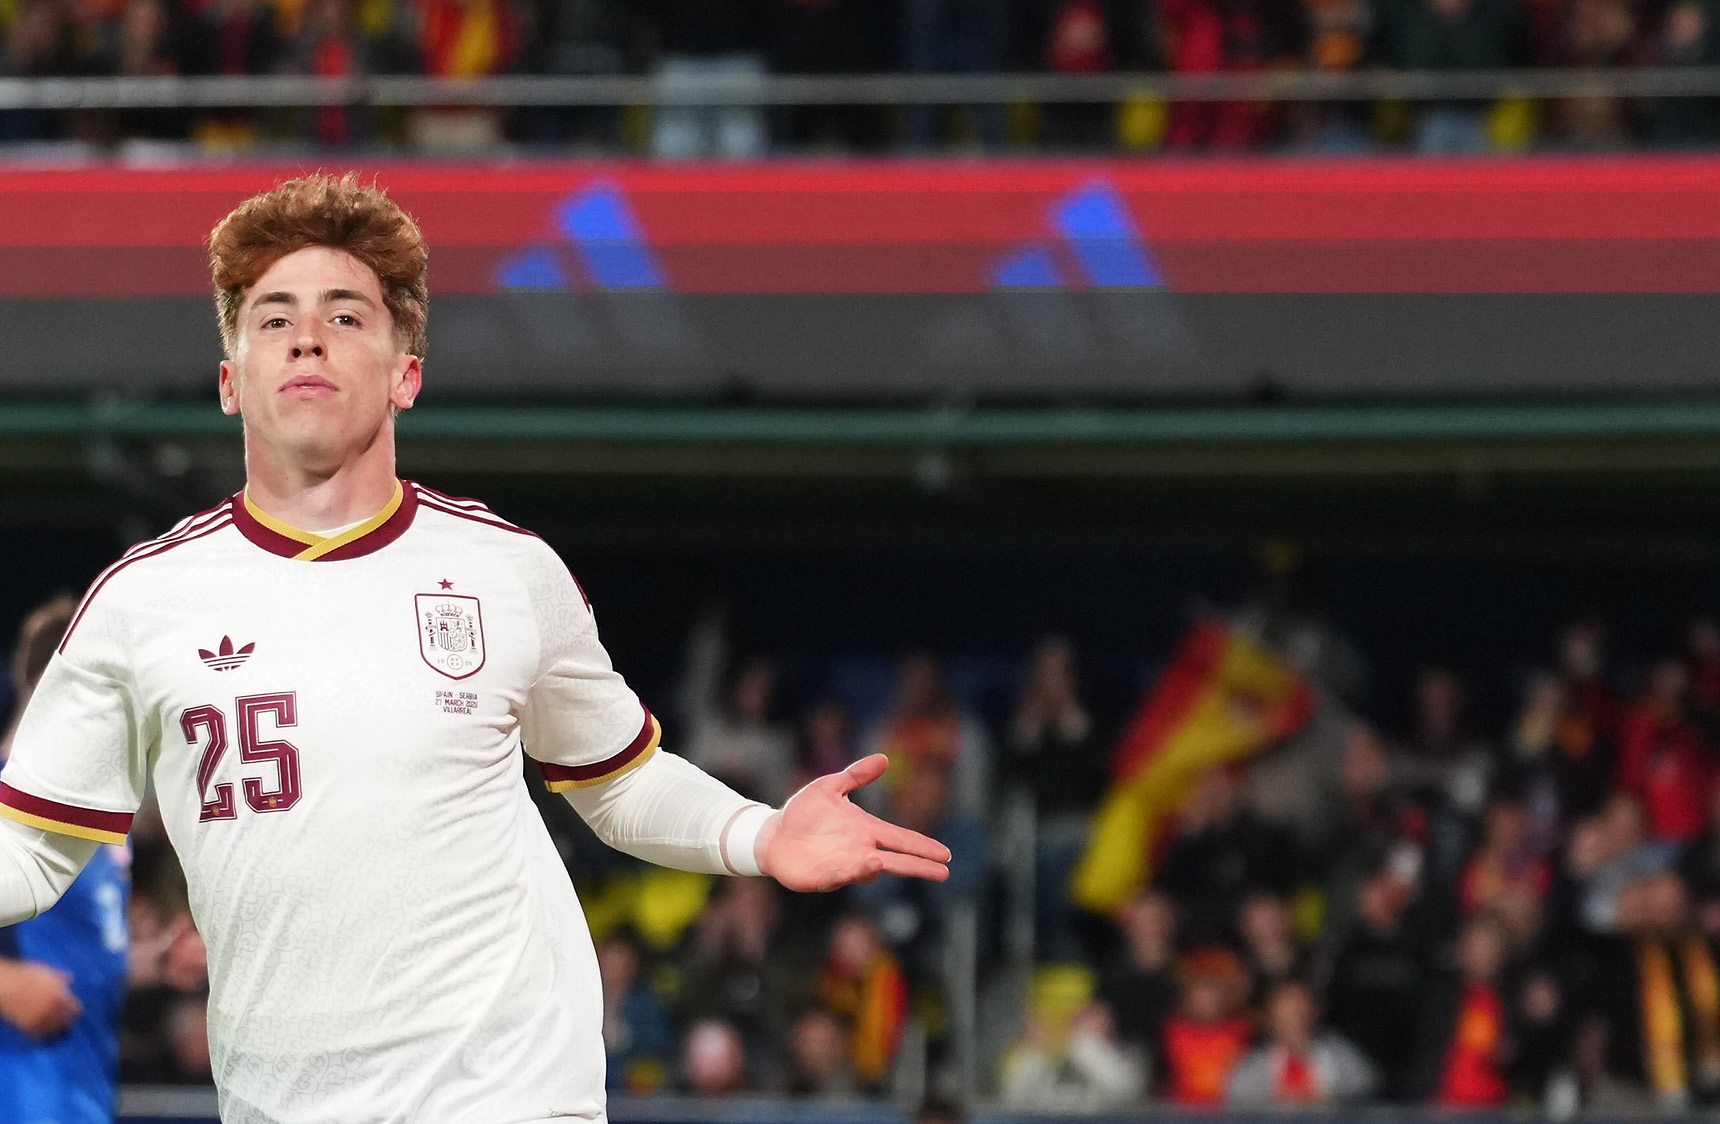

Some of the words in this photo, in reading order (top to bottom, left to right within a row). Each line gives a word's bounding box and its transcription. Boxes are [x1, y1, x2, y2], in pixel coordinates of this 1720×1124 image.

[435, 690, 453, 698] SPAIN
[459, 691, 478, 700] SERBIA
[435, 698, 442, 706] 27
[444, 698, 464, 707] MARCH
[443, 705, 472, 715] VILLARREAL
[179, 690, 303, 824] 25
